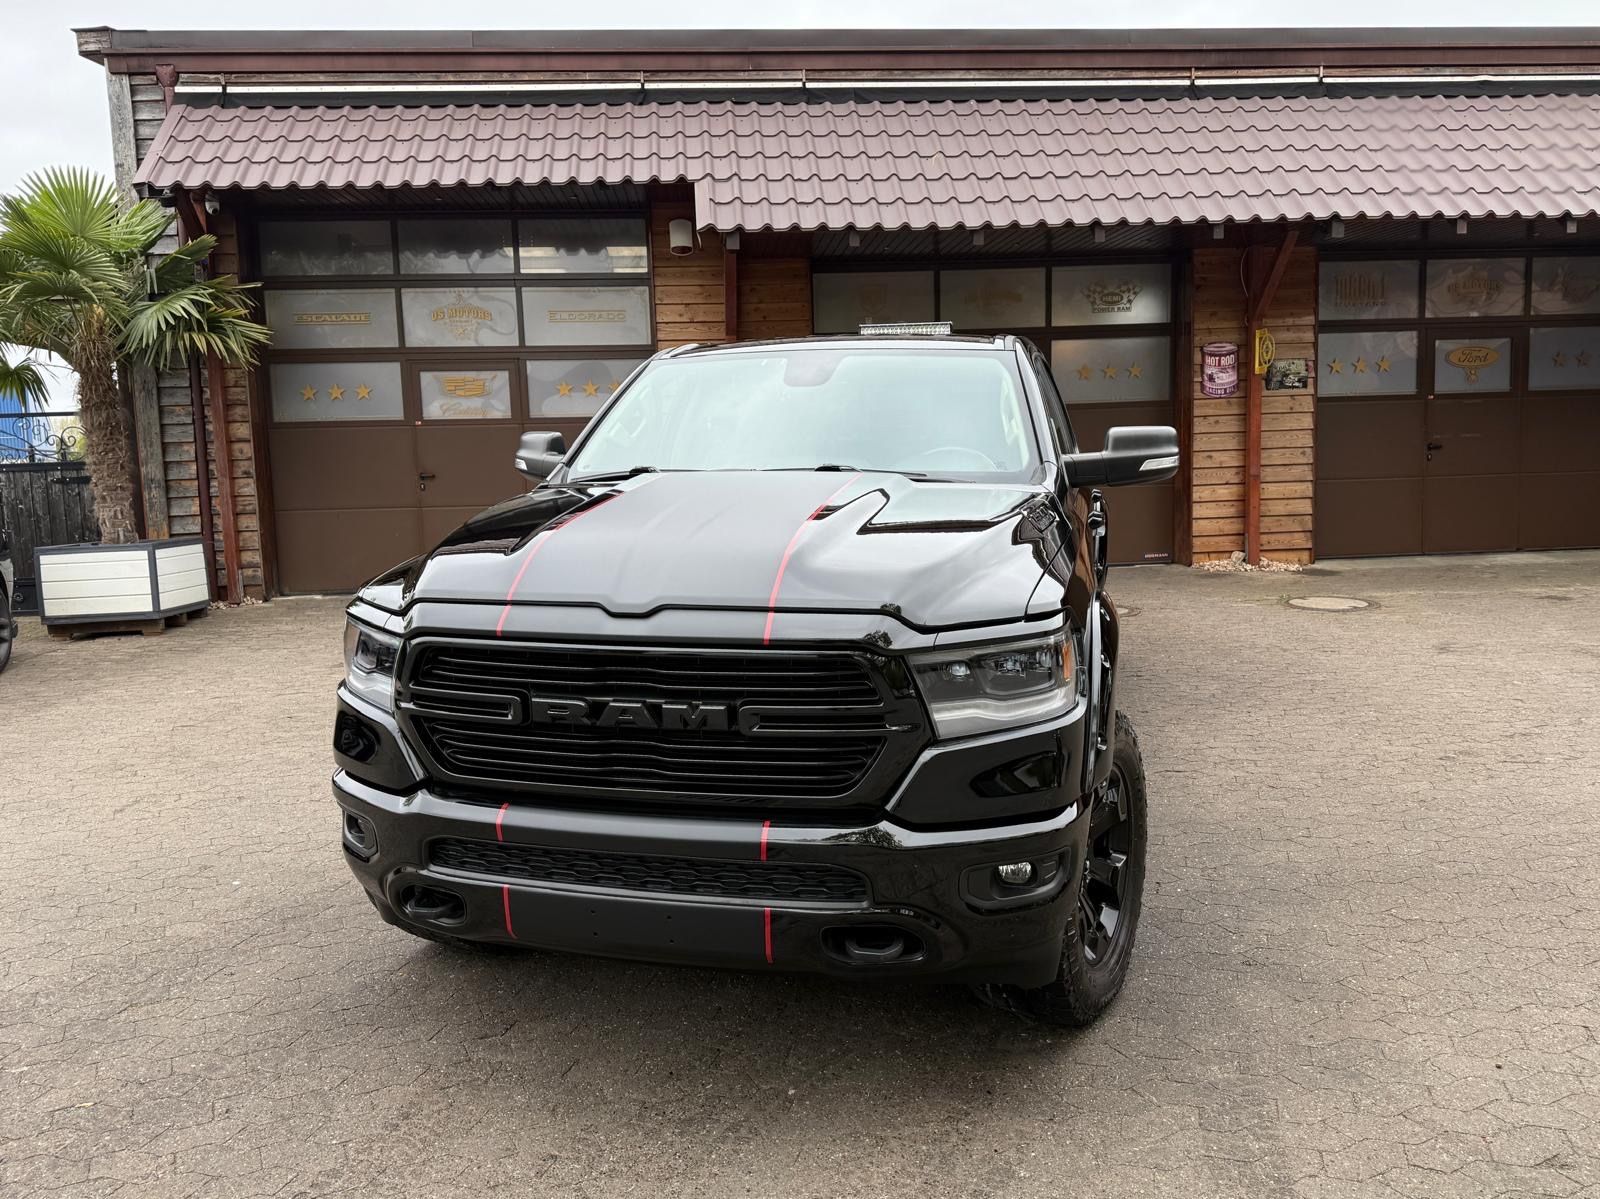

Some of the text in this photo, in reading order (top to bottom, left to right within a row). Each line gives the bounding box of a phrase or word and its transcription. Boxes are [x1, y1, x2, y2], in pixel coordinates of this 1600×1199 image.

[296, 314, 370, 322] ESCALADE
[431, 307, 493, 321] US MOTORS
[549, 312, 626, 321] ELDORADO
[1205, 354, 1235, 366] HOT ROD
[1458, 349, 1490, 363] Ford
[531, 697, 730, 731] RAM
